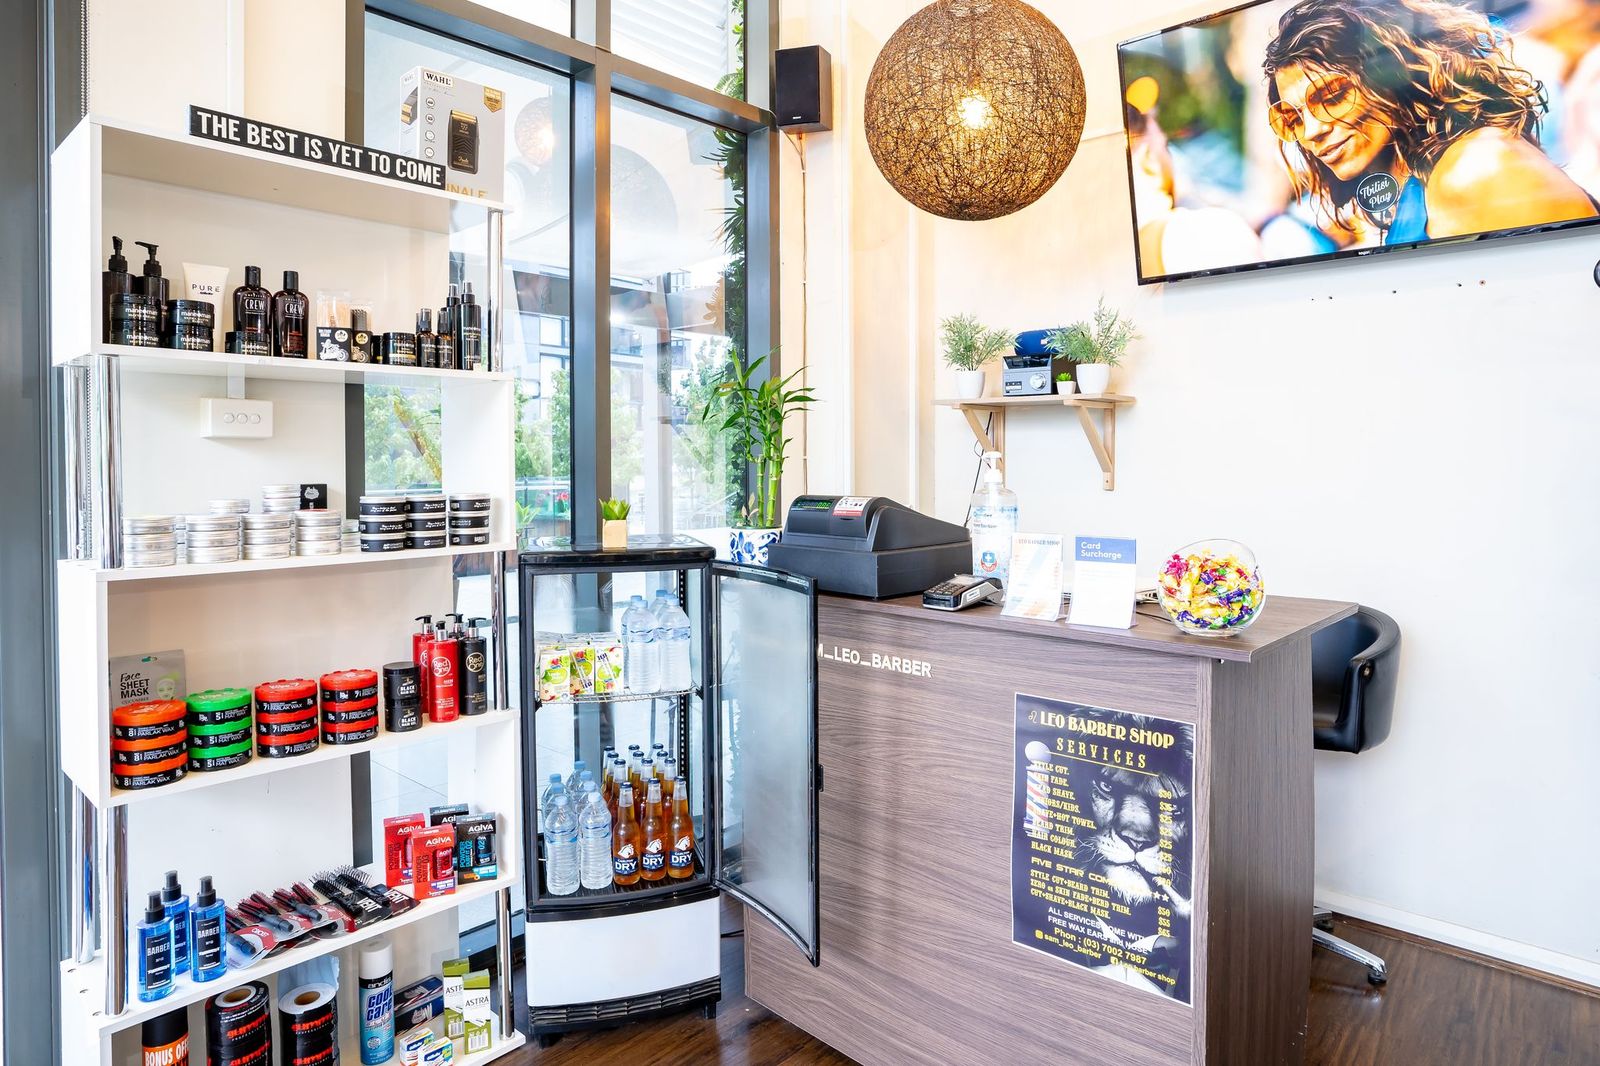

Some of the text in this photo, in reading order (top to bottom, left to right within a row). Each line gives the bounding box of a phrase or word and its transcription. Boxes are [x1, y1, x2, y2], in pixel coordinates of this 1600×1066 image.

[425, 72, 451, 86] WAHL
[197, 111, 442, 185] THE BEST IS YET TO COME
[1359, 178, 1390, 199] Tbilisi
[1369, 190, 1392, 208] Play
[192, 283, 220, 293] PURE
[245, 299, 265, 310] CREW
[285, 302, 304, 315] CREW
[1081, 541, 1101, 550] Card
[1081, 550, 1122, 560] Surcharge
[120, 672, 141, 683] Face
[120, 679, 150, 691] SHEET
[120, 687, 149, 699] MASK
[1041, 711, 1175, 749] LEO BARBER SHOP
[1056, 737, 1146, 769] SERVICES
[468, 823, 493, 833] AGIVA
[426, 836, 452, 846] AGIVA
[1031, 841, 1053, 854] BLACK
[643, 856, 664, 866] DRY
[671, 853, 692, 864] DRY
[615, 861, 637, 871] DRY
[1031, 856, 1052, 869] FIVE
[1056, 863, 1085, 878] STAR
[357, 897, 382, 913] VENT
[1048, 906, 1063, 917] ALL
[1064, 911, 1102, 929] SERVICES
[1048, 915, 1067, 928] FREE
[1068, 921, 1086, 934] WAX
[198, 926, 220, 939] BARBER
[147, 942, 170, 957] BARBER
[1054, 927, 1077, 942] Phon
[1083, 937, 1100, 951] (03)
[1102, 943, 1123, 958] 7002
[1125, 950, 1148, 965] 7987
[1158, 972, 1176, 986] shop
[465, 996, 489, 1008] ASTRA
[144, 1047, 173, 1066] BONUS
